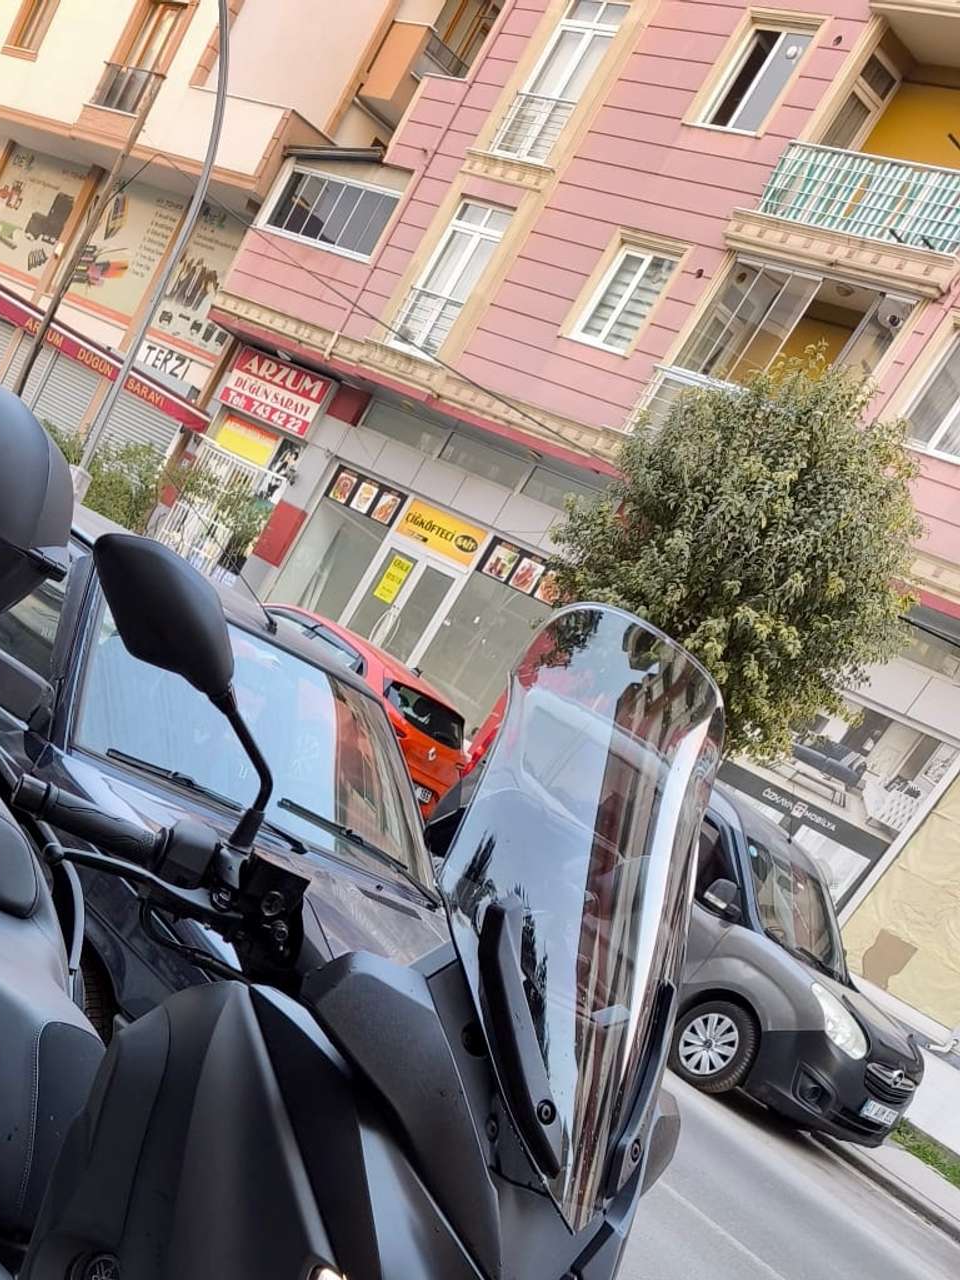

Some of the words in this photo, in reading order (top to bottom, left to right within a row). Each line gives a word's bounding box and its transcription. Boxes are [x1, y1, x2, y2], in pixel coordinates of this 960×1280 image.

[24, 318, 64, 348] ARUM
[244, 355, 323, 398] ARZUM
[250, 400, 271, 418] 743
[271, 409, 287, 425] 42
[285, 415, 303, 432] 22
